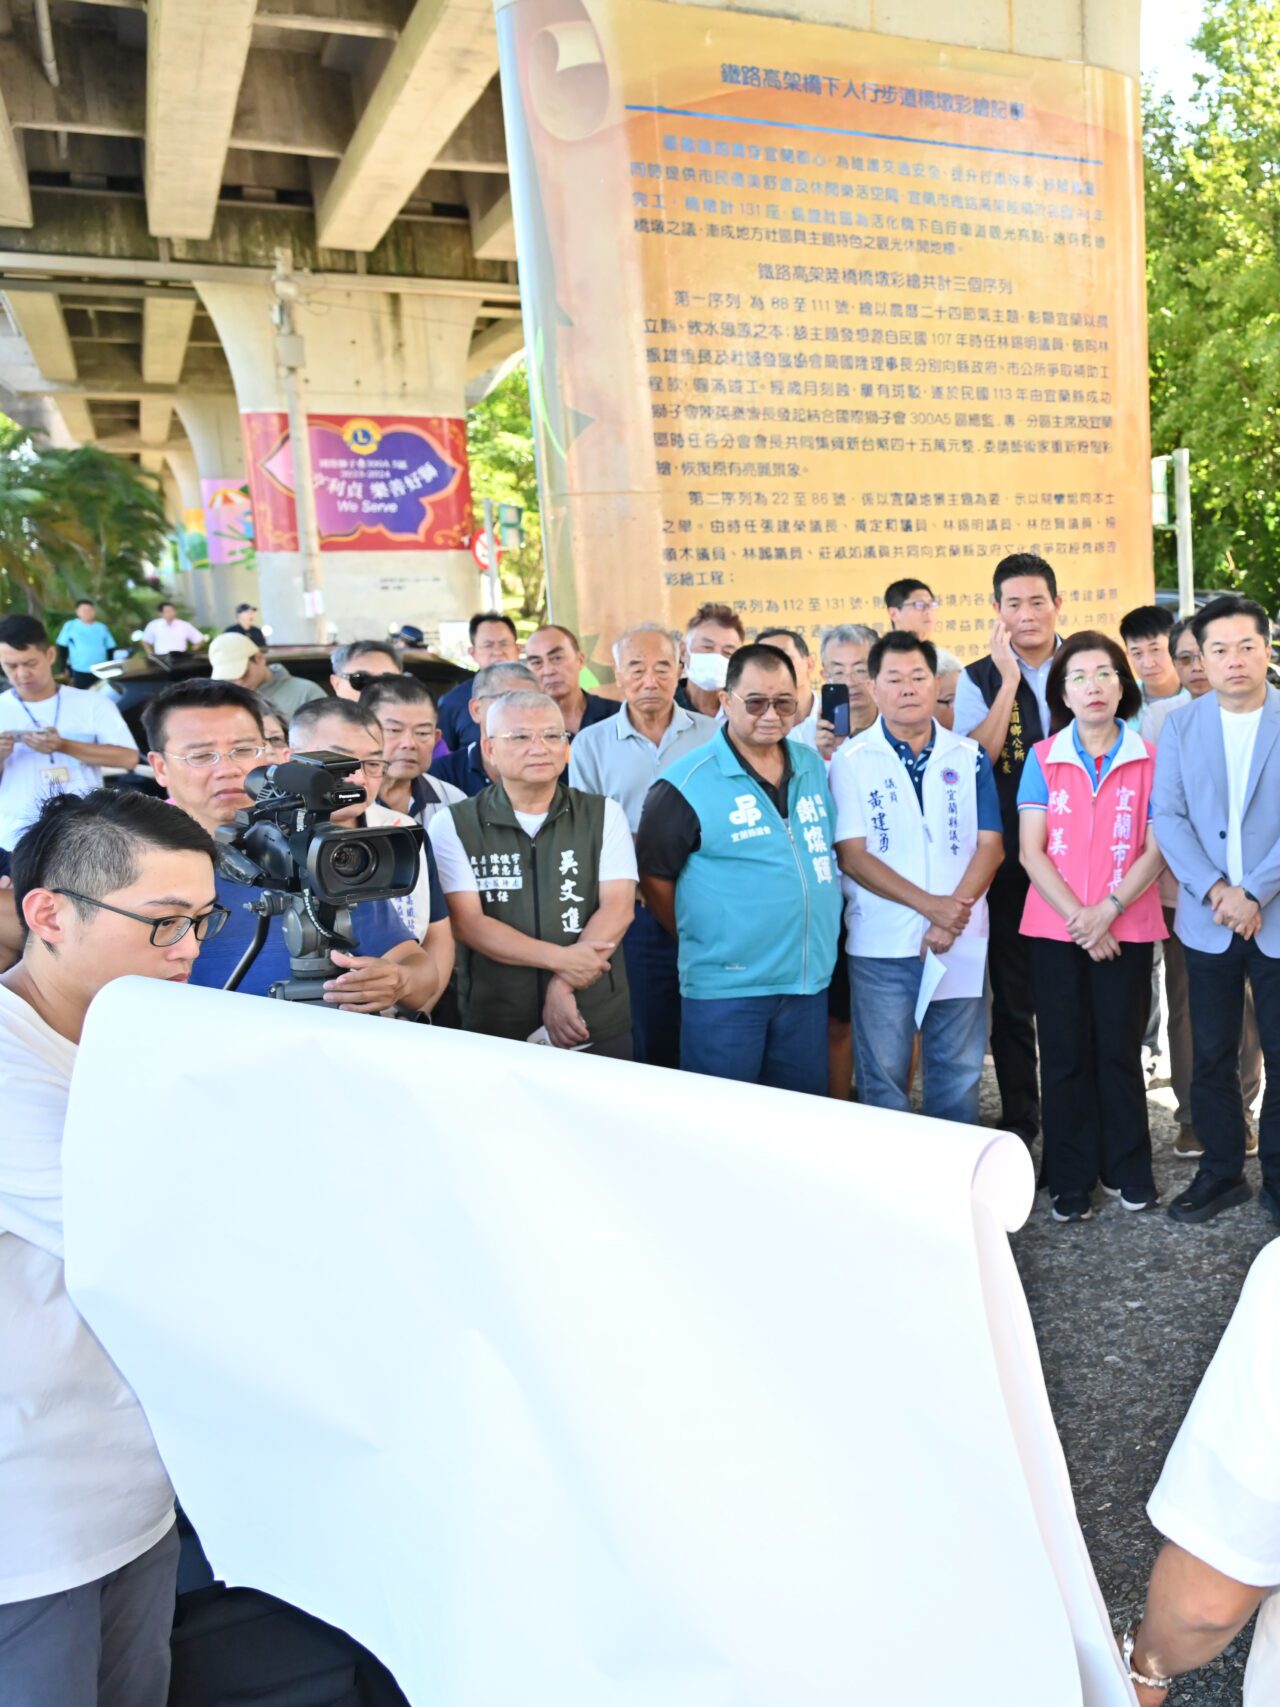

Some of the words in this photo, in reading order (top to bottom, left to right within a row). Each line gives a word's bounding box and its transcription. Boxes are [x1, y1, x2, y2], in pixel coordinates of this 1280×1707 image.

[361, 500, 398, 513] Serve
[558, 849, 584, 934] 吳文進
